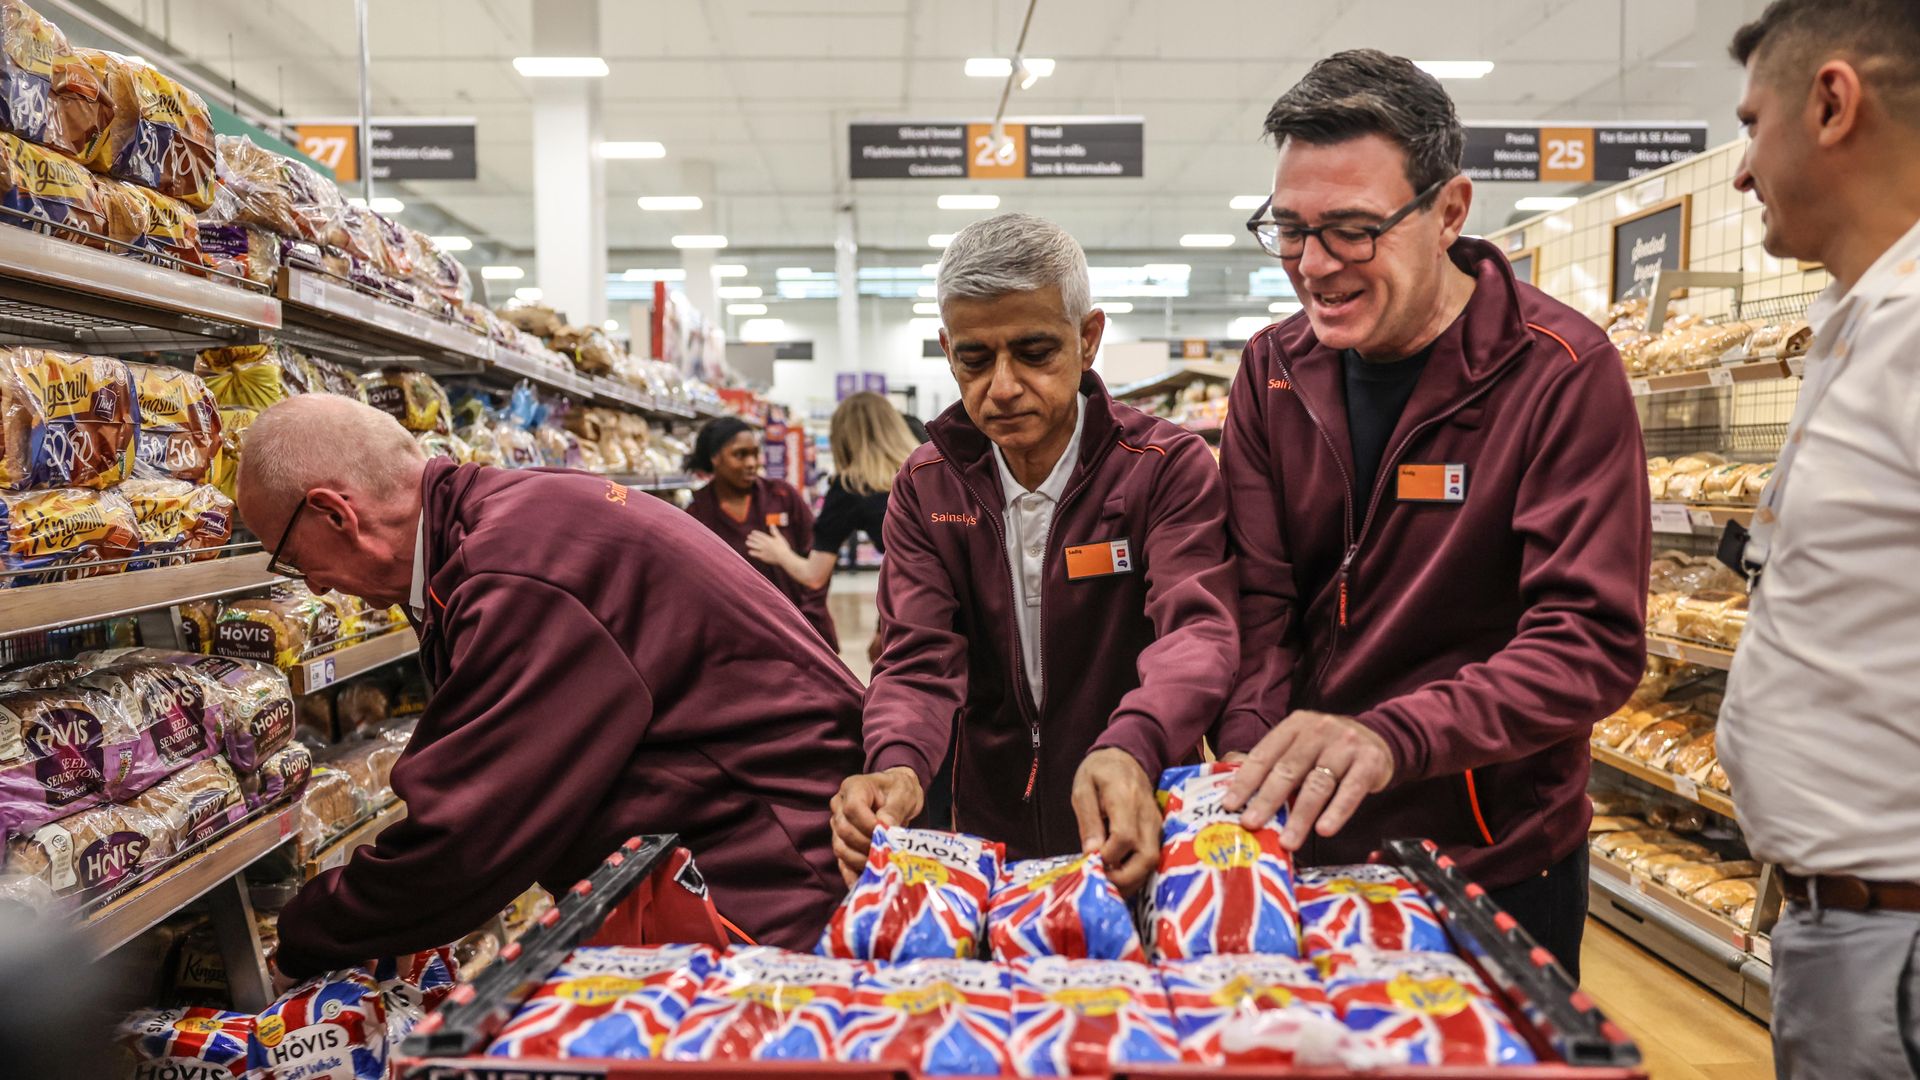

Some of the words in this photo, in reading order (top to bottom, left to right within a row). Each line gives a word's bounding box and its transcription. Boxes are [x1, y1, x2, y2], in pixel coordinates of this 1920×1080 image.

[898, 127, 929, 139] Sliced
[931, 127, 963, 139] bread
[1030, 126, 1063, 139] Bread
[1505, 132, 1535, 145] Pasta
[1599, 132, 1616, 144] Far
[1617, 132, 1638, 144] East
[1639, 132, 1648, 144] &
[1649, 132, 1661, 144] SE
[1662, 131, 1691, 144] Asian
[304, 137, 348, 169] 27
[862, 145, 917, 159] Flatbreads
[919, 145, 928, 158] &
[929, 146, 963, 159] Wraps
[1030, 144, 1061, 157] Bread
[1063, 144, 1087, 157] rolls
[1494, 149, 1539, 162] Mexican
[1547, 139, 1586, 169] 25
[1635, 150, 1659, 162] Rice
[1660, 150, 1670, 162] &
[908, 163, 963, 176] Croissants
[1032, 161, 1052, 175] Jam
[1053, 162, 1063, 174] &
[1064, 161, 1123, 175] Marmalade
[140, 433, 197, 470] 50/50
[22, 503, 107, 555] Kingsmill
[219, 626, 270, 643] HOVIS
[217, 647, 270, 660] Wholemeal
[253, 702, 290, 735] HOVIS
[61, 757, 88, 770] SEED
[283, 755, 310, 777] HOVIS
[273, 1030, 339, 1064] HOVIS
[284, 1064, 306, 1080] Soft
[308, 1055, 343, 1074] White
